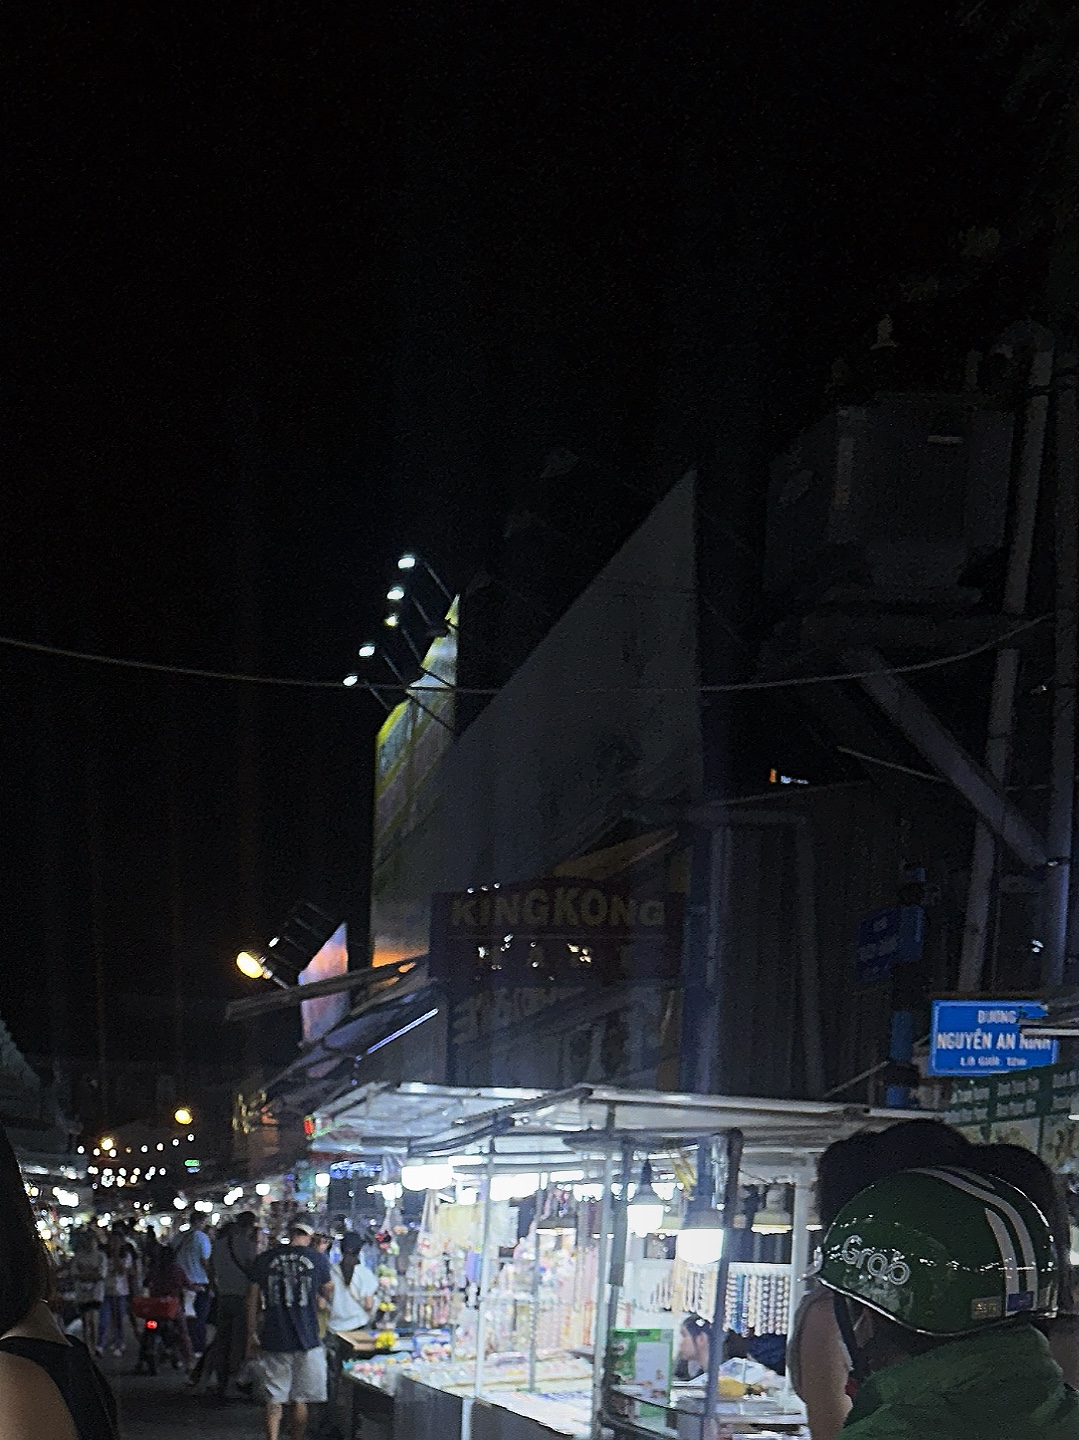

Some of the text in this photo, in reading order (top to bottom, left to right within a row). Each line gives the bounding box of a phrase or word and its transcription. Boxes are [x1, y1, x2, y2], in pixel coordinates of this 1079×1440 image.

[449, 886, 667, 928] KINGKONG
[996, 1032, 1016, 1051] AN
[841, 1234, 910, 1286] Grab
